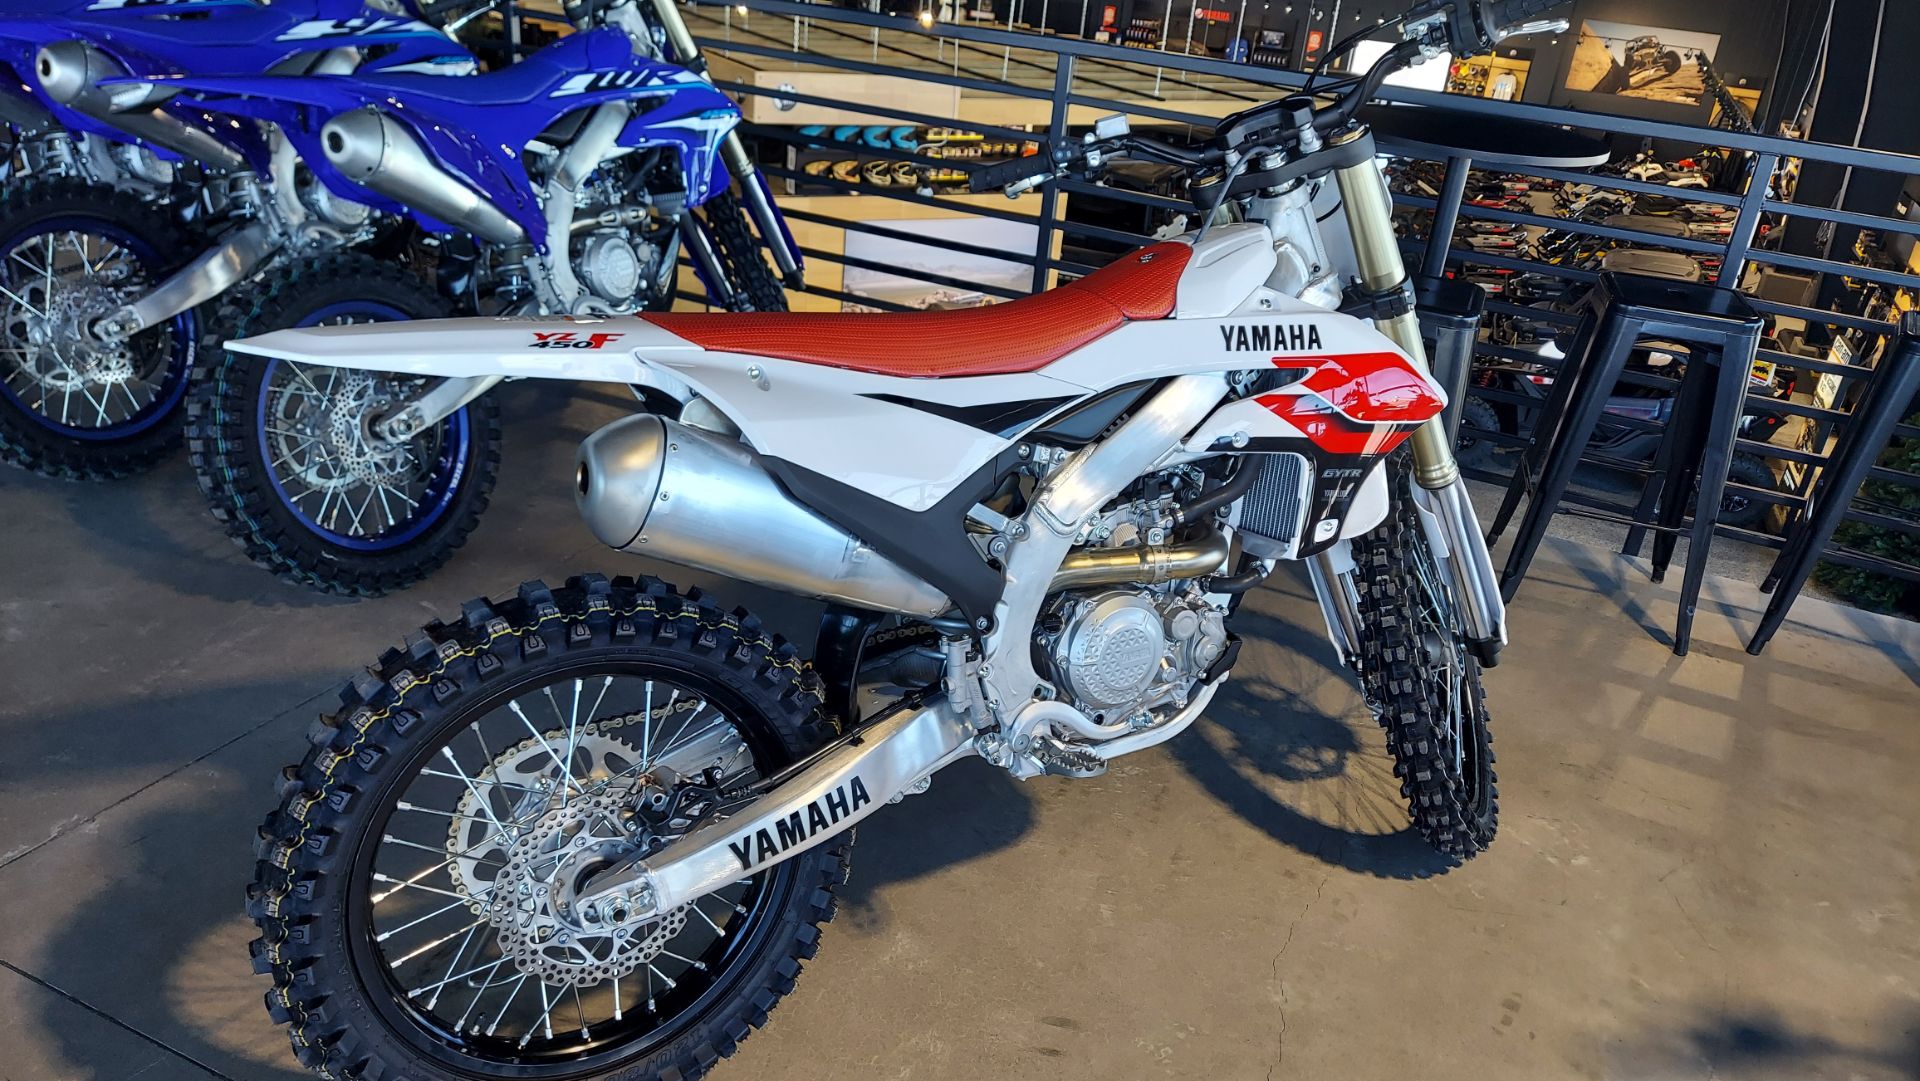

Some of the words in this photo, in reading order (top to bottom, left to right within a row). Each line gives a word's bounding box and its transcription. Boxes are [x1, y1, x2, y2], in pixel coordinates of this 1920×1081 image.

[1220, 324, 1323, 352] YAMAHA
[1321, 468, 1364, 479] GYTR
[728, 775, 871, 871] YAMAHA
